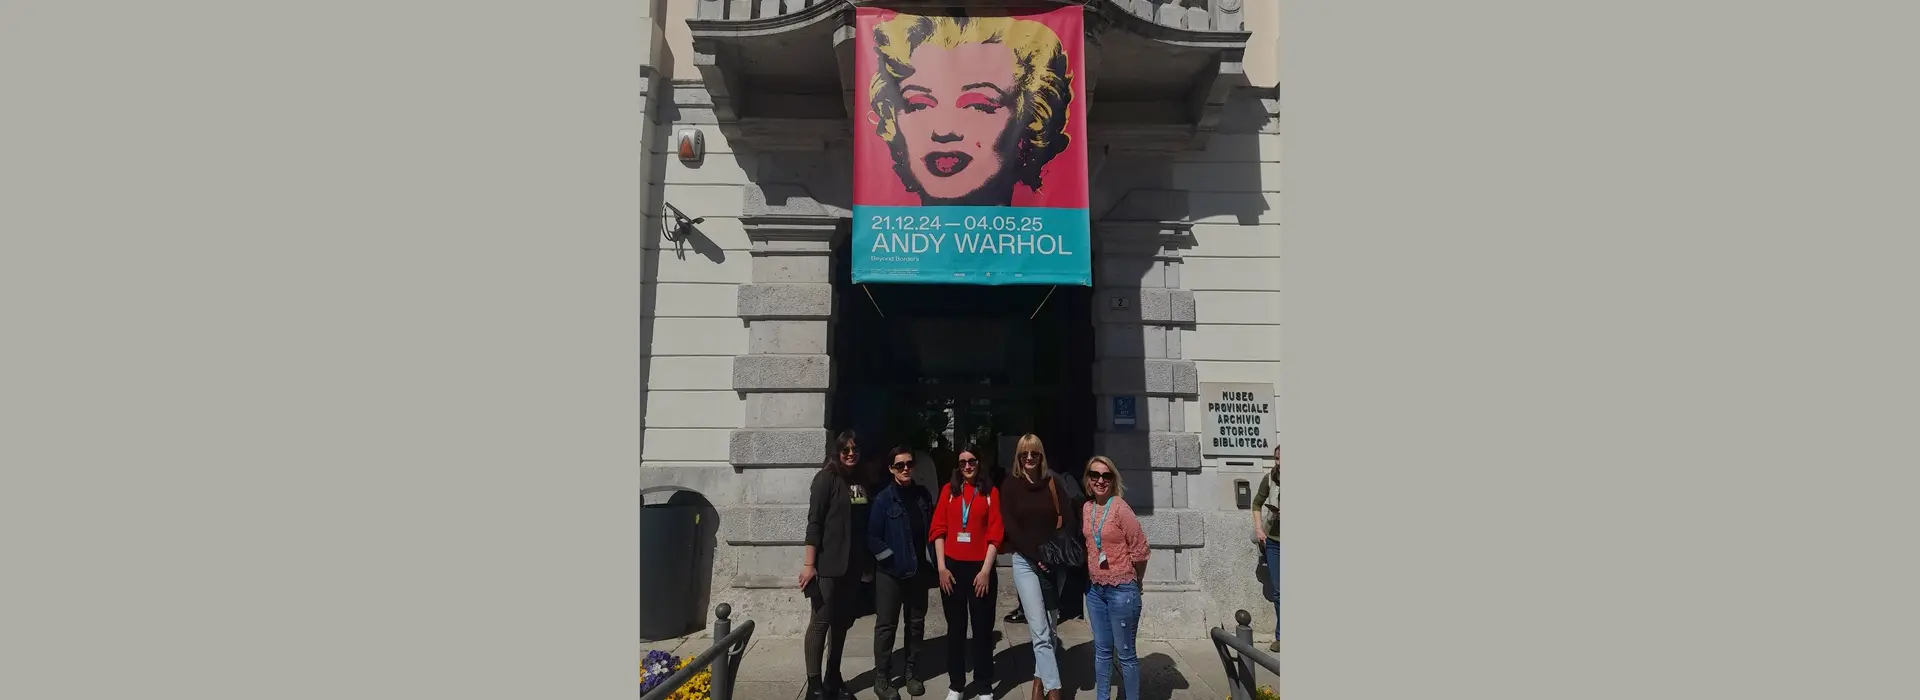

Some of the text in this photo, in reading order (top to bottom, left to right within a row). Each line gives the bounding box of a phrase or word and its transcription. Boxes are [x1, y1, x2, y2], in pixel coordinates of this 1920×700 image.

[871, 215, 942, 231] 21.12.24
[964, 215, 1043, 232] 04.05.25
[871, 232, 1073, 255] ANDY WARHOL
[870, 255, 920, 263] Beyond Borders
[1118, 298, 1123, 307] 2
[1222, 391, 1254, 402] MUSEO
[1208, 402, 1269, 414] PROVINCIALE
[1217, 414, 1261, 425] ARCHIVIO
[1220, 426, 1260, 437] STORICO
[1213, 437, 1269, 449] BIBLIOTECA
